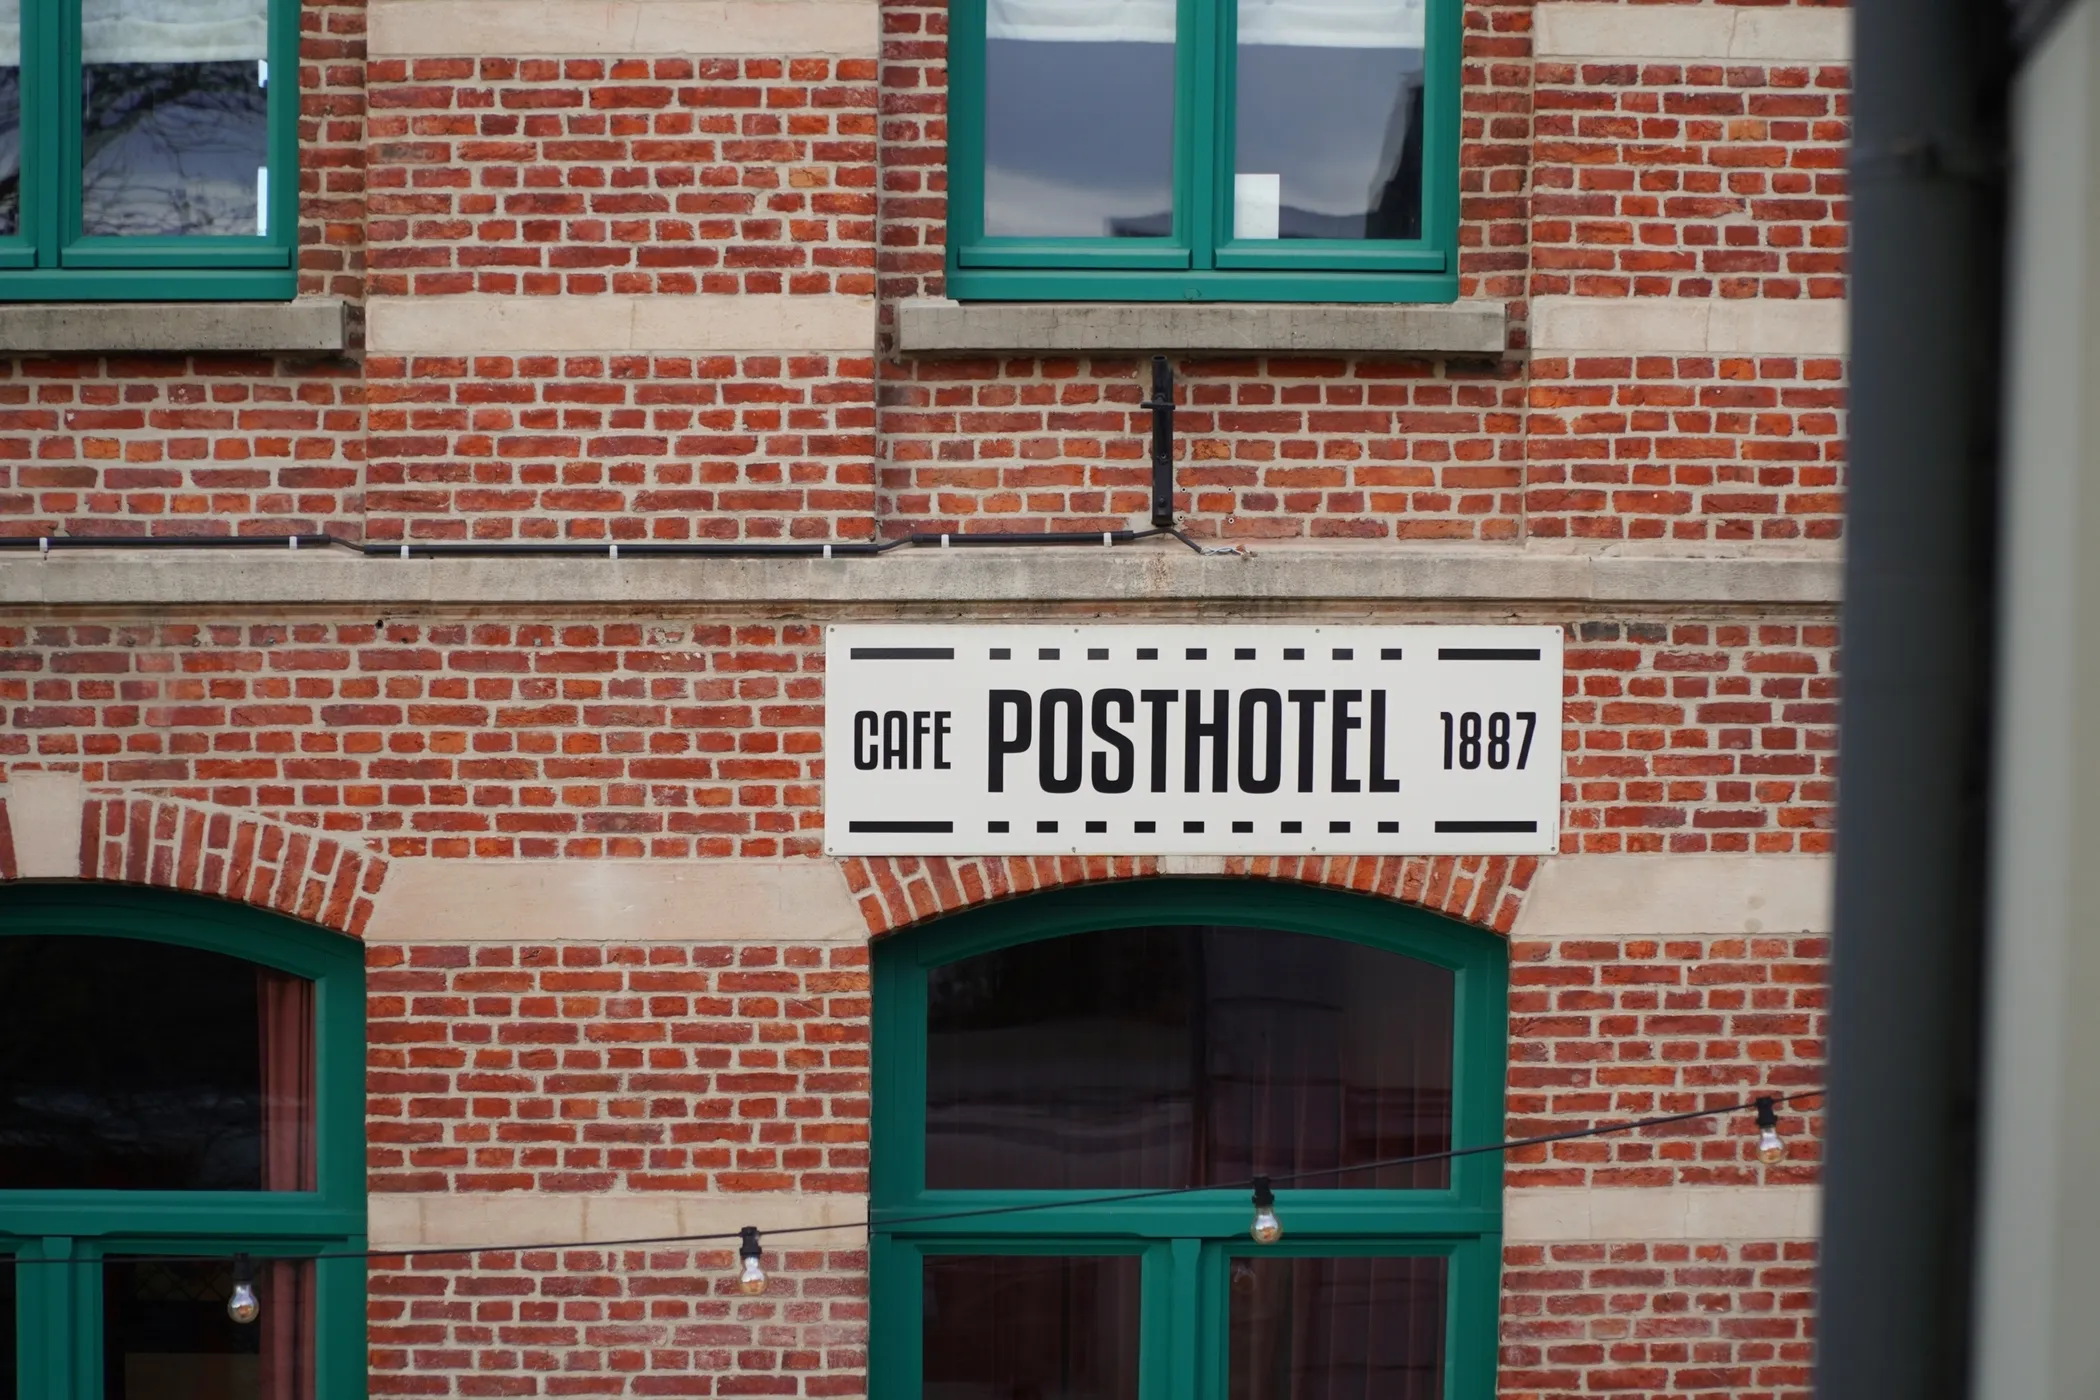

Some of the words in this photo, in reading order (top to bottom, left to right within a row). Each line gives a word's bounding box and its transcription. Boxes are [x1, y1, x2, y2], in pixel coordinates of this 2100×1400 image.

[854, 710, 952, 771] CAFE
[987, 688, 1400, 794] POSTHOTEL
[1440, 711, 1537, 770] 1887
